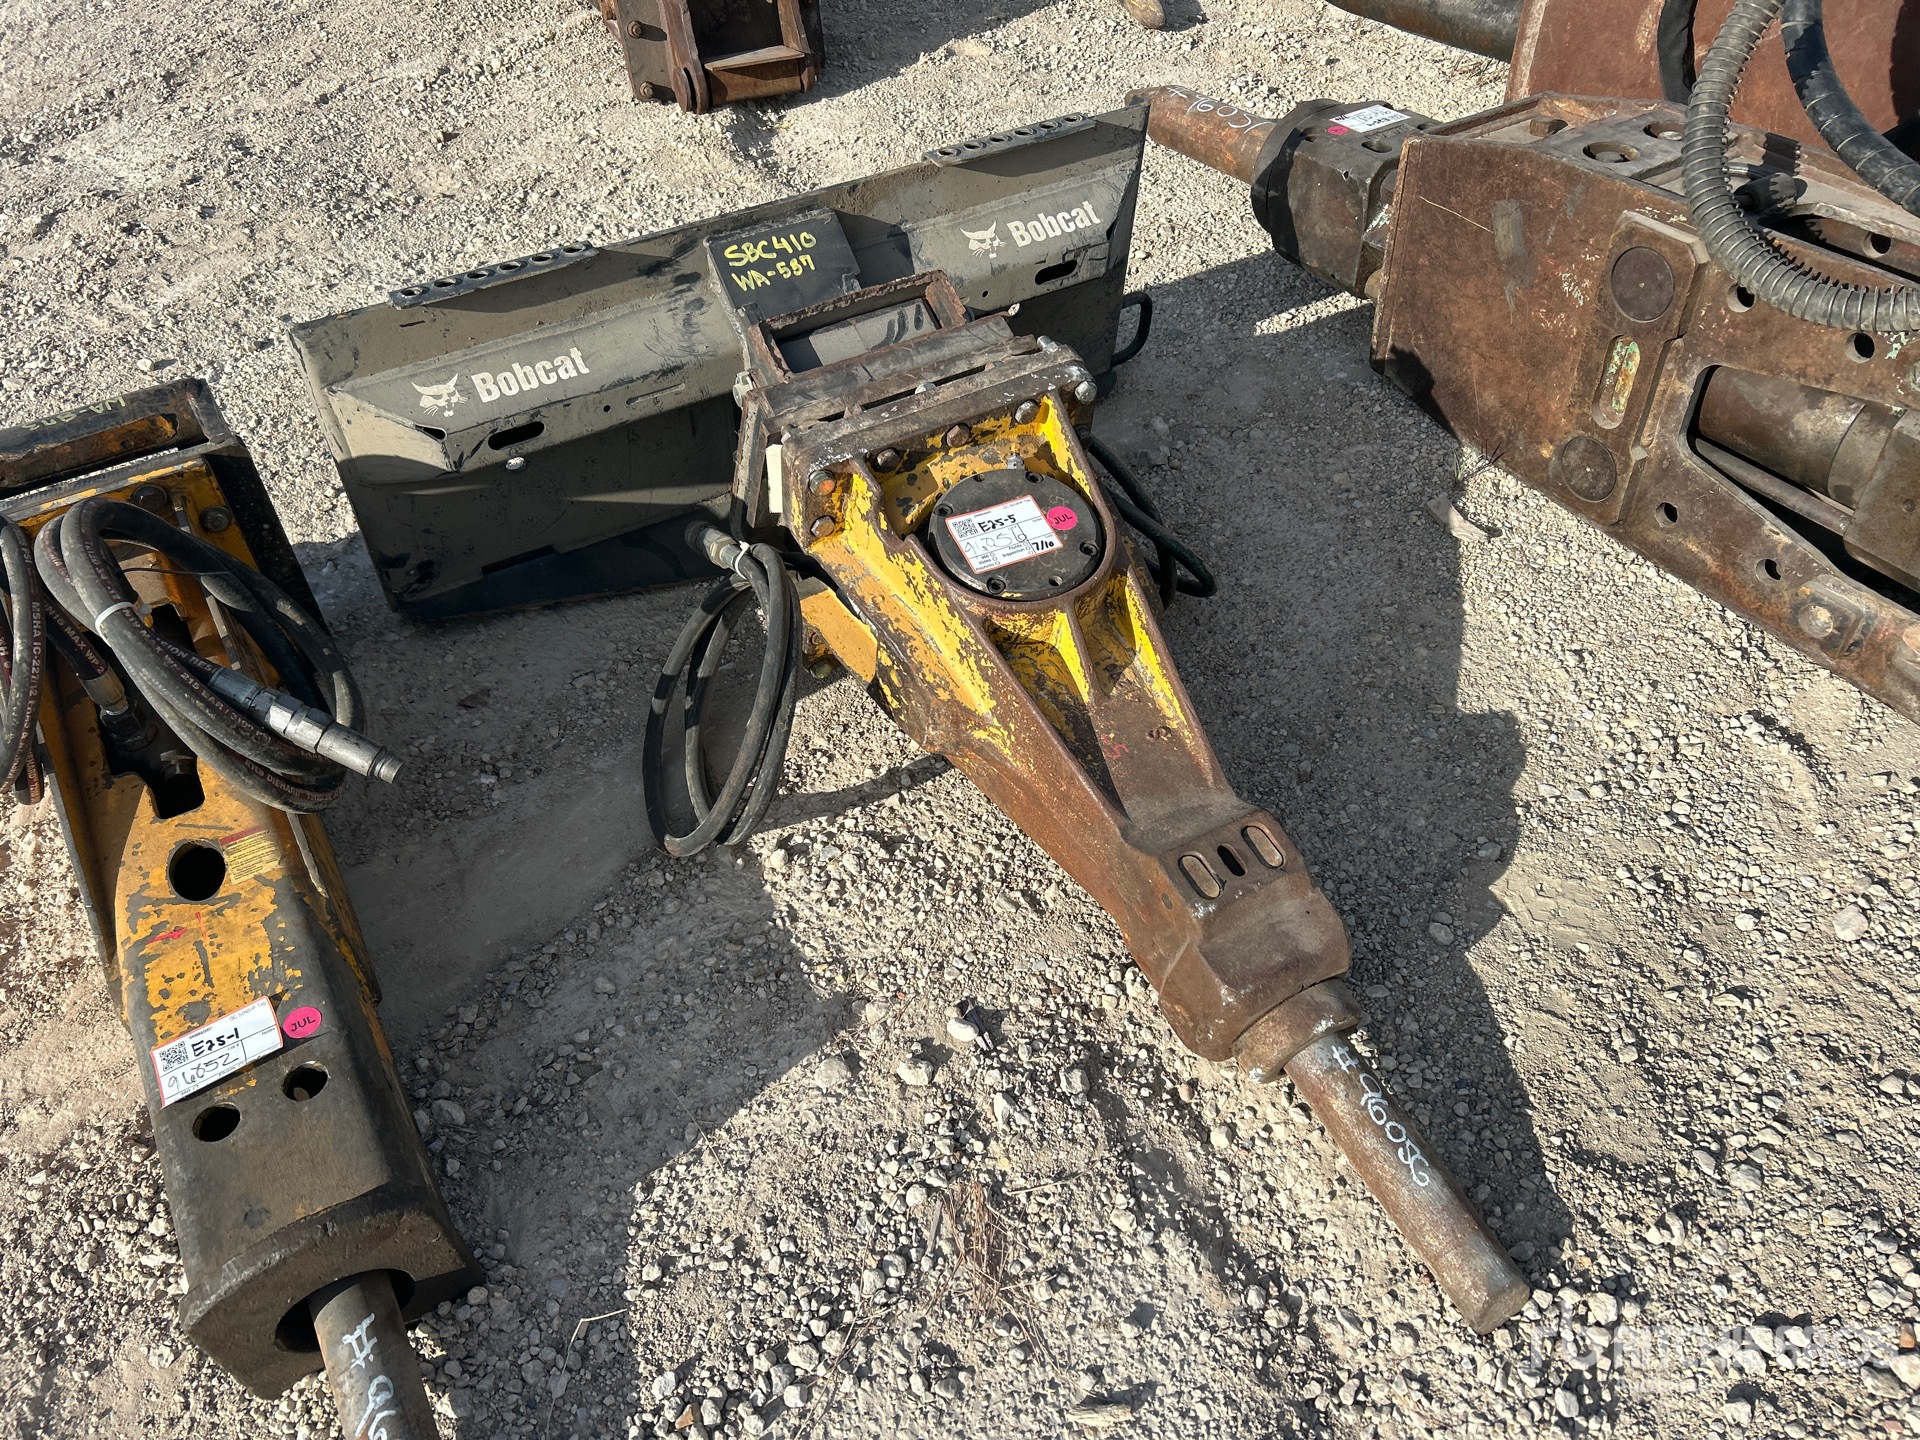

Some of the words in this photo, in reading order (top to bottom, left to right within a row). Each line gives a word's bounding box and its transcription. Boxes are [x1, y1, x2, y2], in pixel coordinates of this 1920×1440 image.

[1006, 200, 1101, 248] Bobcat
[724, 231, 817, 267] SBC410
[731, 254, 815, 292] WA-587
[471, 346, 590, 403] Bobcat
[978, 514, 1016, 533] E25-5
[1053, 514, 1073, 525] JUL
[1032, 540, 1055, 551] 7/10
[31, 602, 42, 637] MSHA
[64, 626, 87, 650] MAX
[85, 649, 100, 665] WP
[181, 672, 201, 690] 215
[290, 1016, 316, 1032] JUL
[191, 1027, 240, 1057] E25-1
